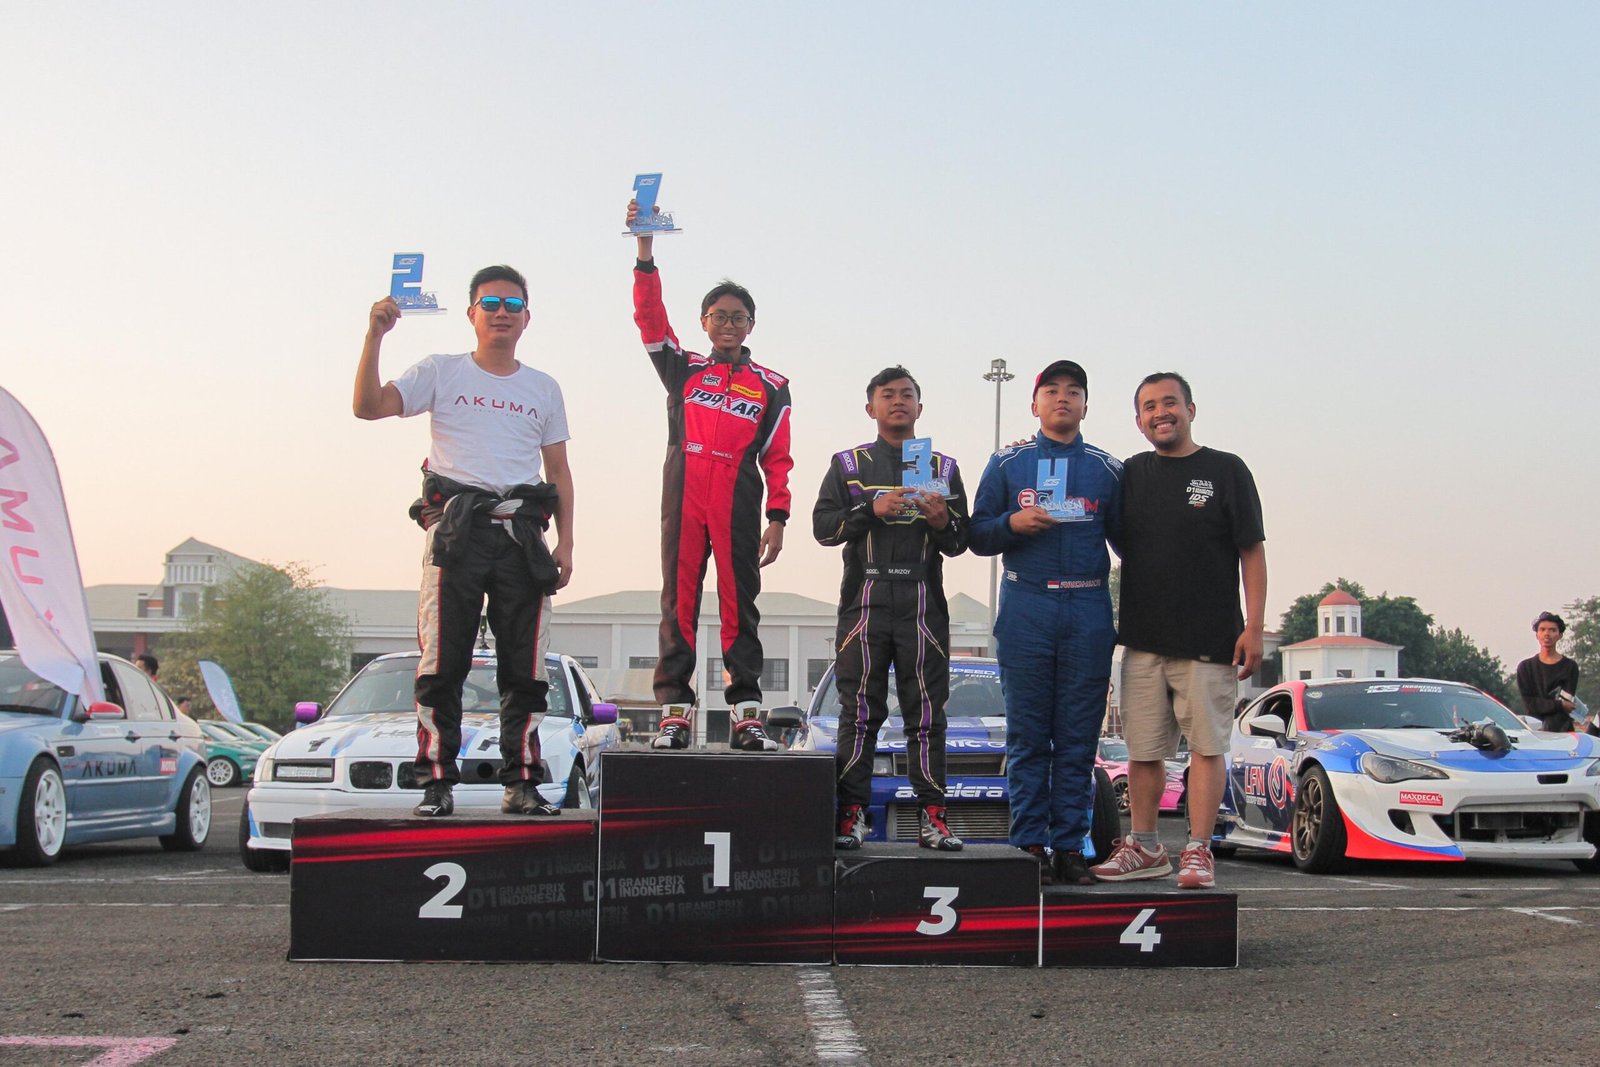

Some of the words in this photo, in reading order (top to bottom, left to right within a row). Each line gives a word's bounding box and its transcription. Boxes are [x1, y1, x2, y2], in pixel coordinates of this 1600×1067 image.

[454, 395, 538, 419] AKUMA
[1189, 494, 1209, 502] IDS
[82, 760, 137, 777] AKUMA
[1400, 793, 1441, 803] MAXDECAL
[704, 832, 731, 887] 1
[418, 862, 467, 919] 2
[618, 876, 657, 888] GRAND
[657, 874, 685, 885] PRIX
[619, 884, 686, 898] INDONESIA
[915, 886, 959, 935] 3
[1119, 908, 1162, 953] 4
